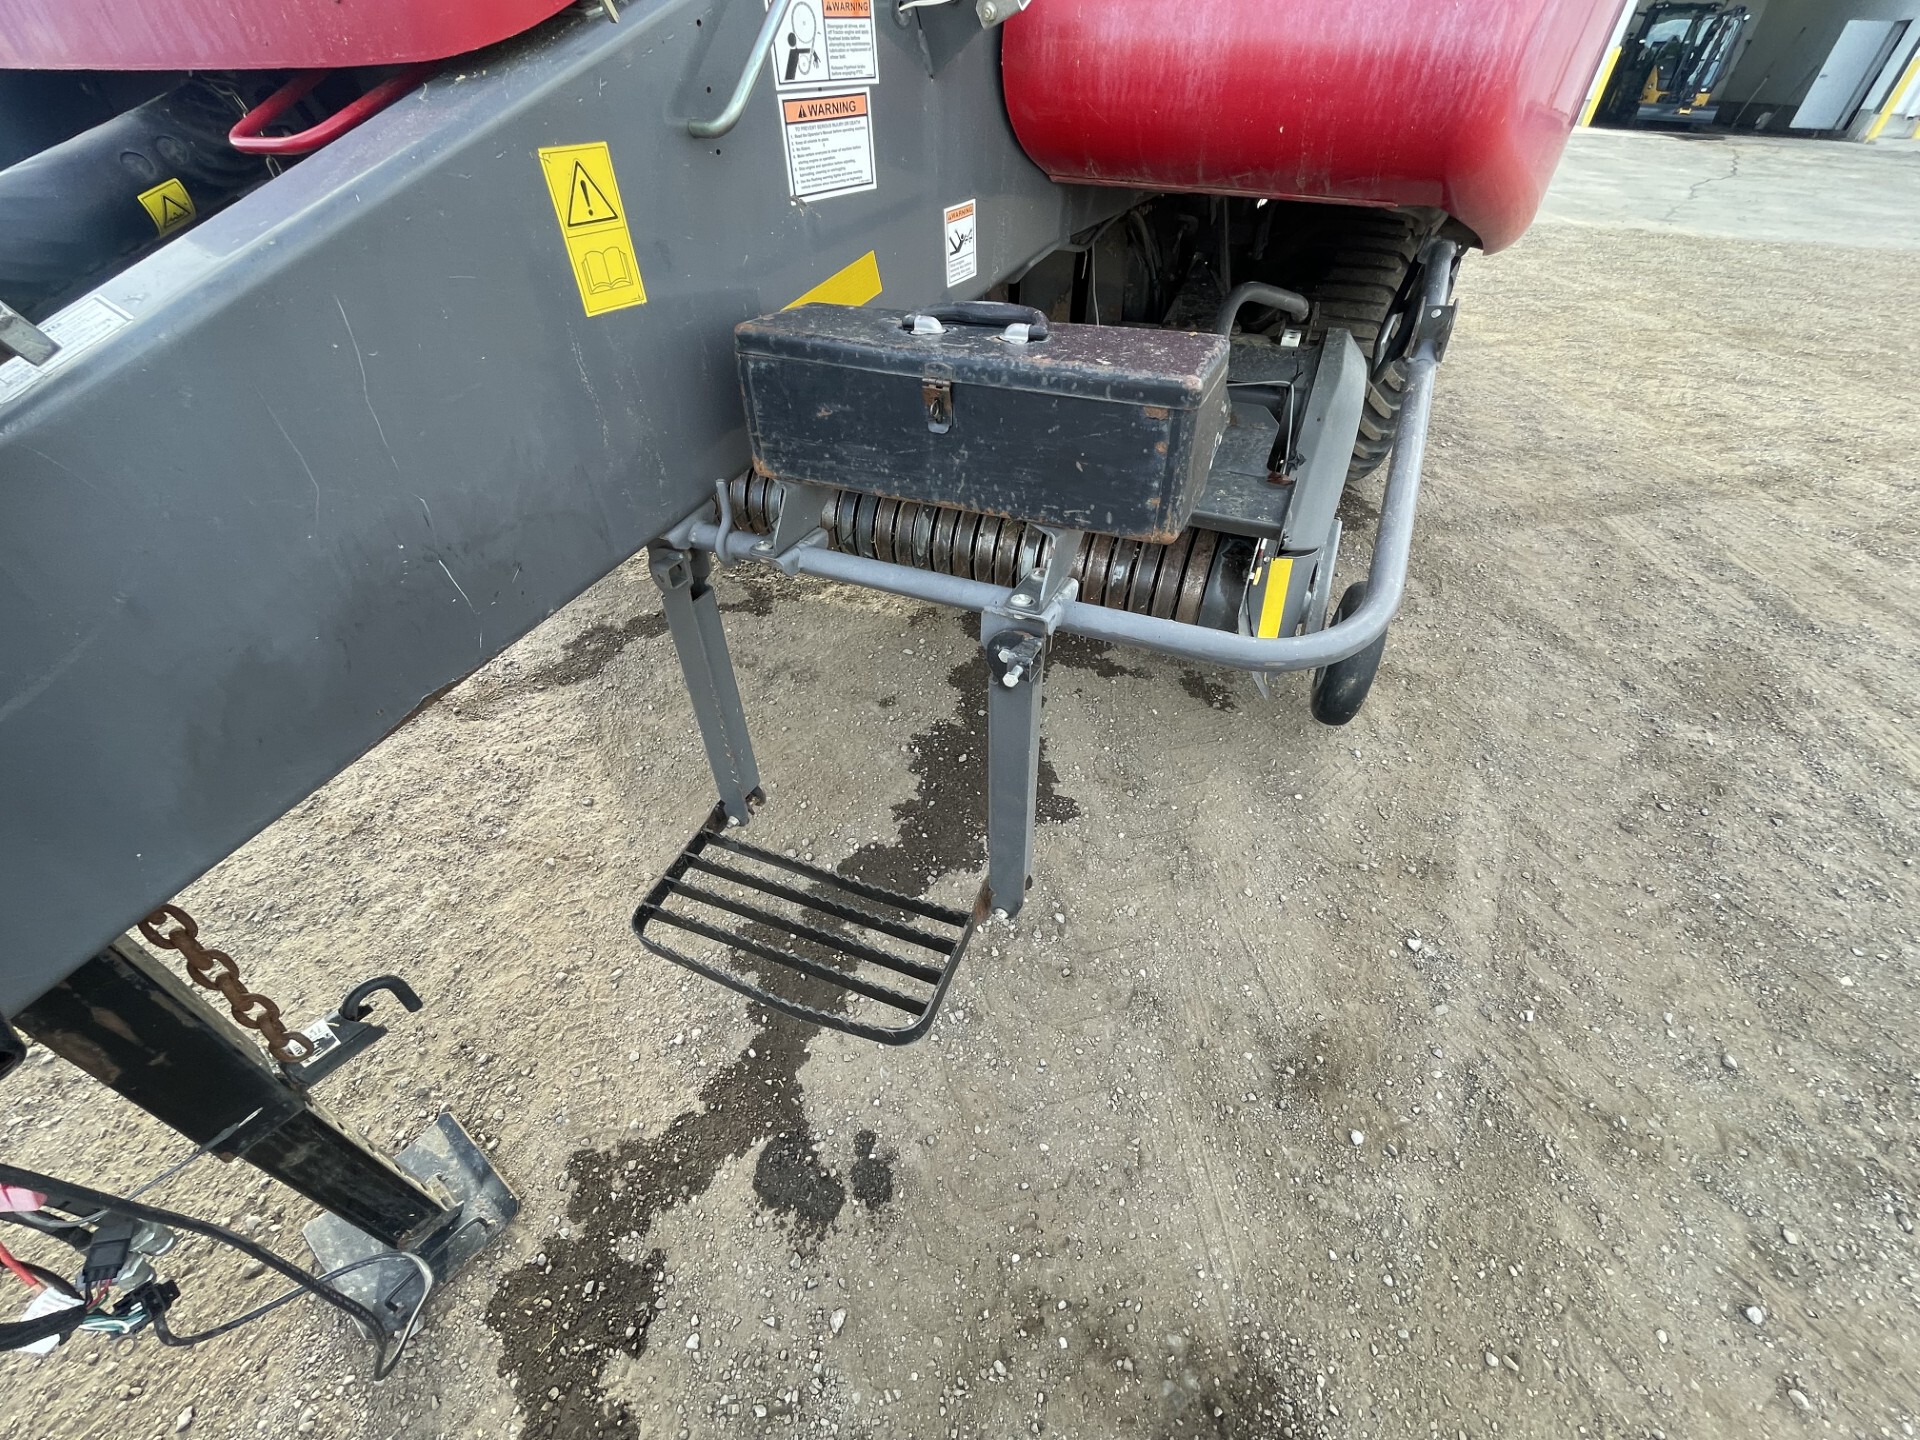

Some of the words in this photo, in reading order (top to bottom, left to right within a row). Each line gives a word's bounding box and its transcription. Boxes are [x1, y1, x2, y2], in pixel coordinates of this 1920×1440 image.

[832, 1, 869, 11] WARNING
[808, 101, 856, 117] WARNING
[951, 206, 973, 219] WARNING
